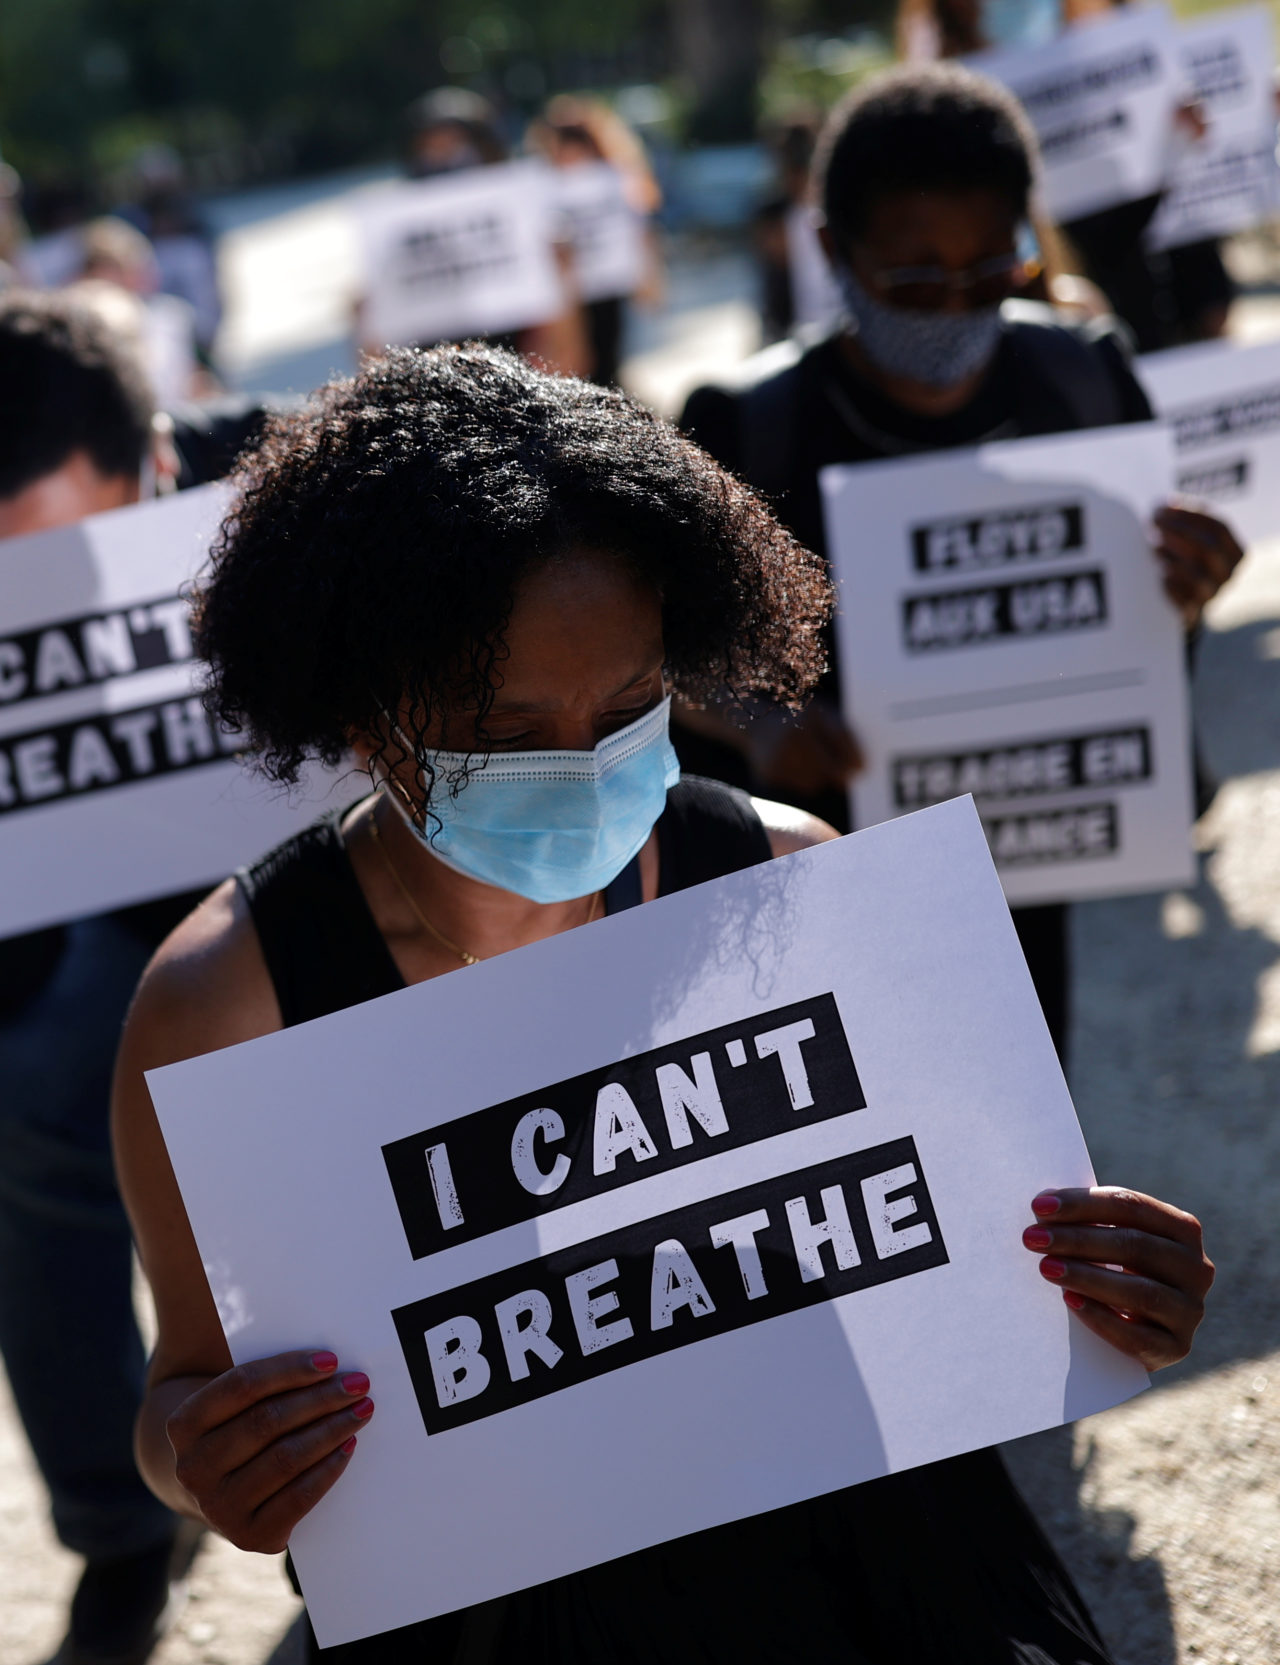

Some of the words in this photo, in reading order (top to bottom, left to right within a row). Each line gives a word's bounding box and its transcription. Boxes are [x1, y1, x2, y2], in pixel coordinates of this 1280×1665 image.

[927, 511, 1069, 568] FLOYD
[909, 593, 1000, 650] AUX
[1008, 578, 1102, 634] USA
[1082, 734, 1146, 780] EN
[424, 1142, 465, 1231] I
[510, 1018, 817, 1198] CAN'T
[424, 1162, 933, 1408] BREATHE
